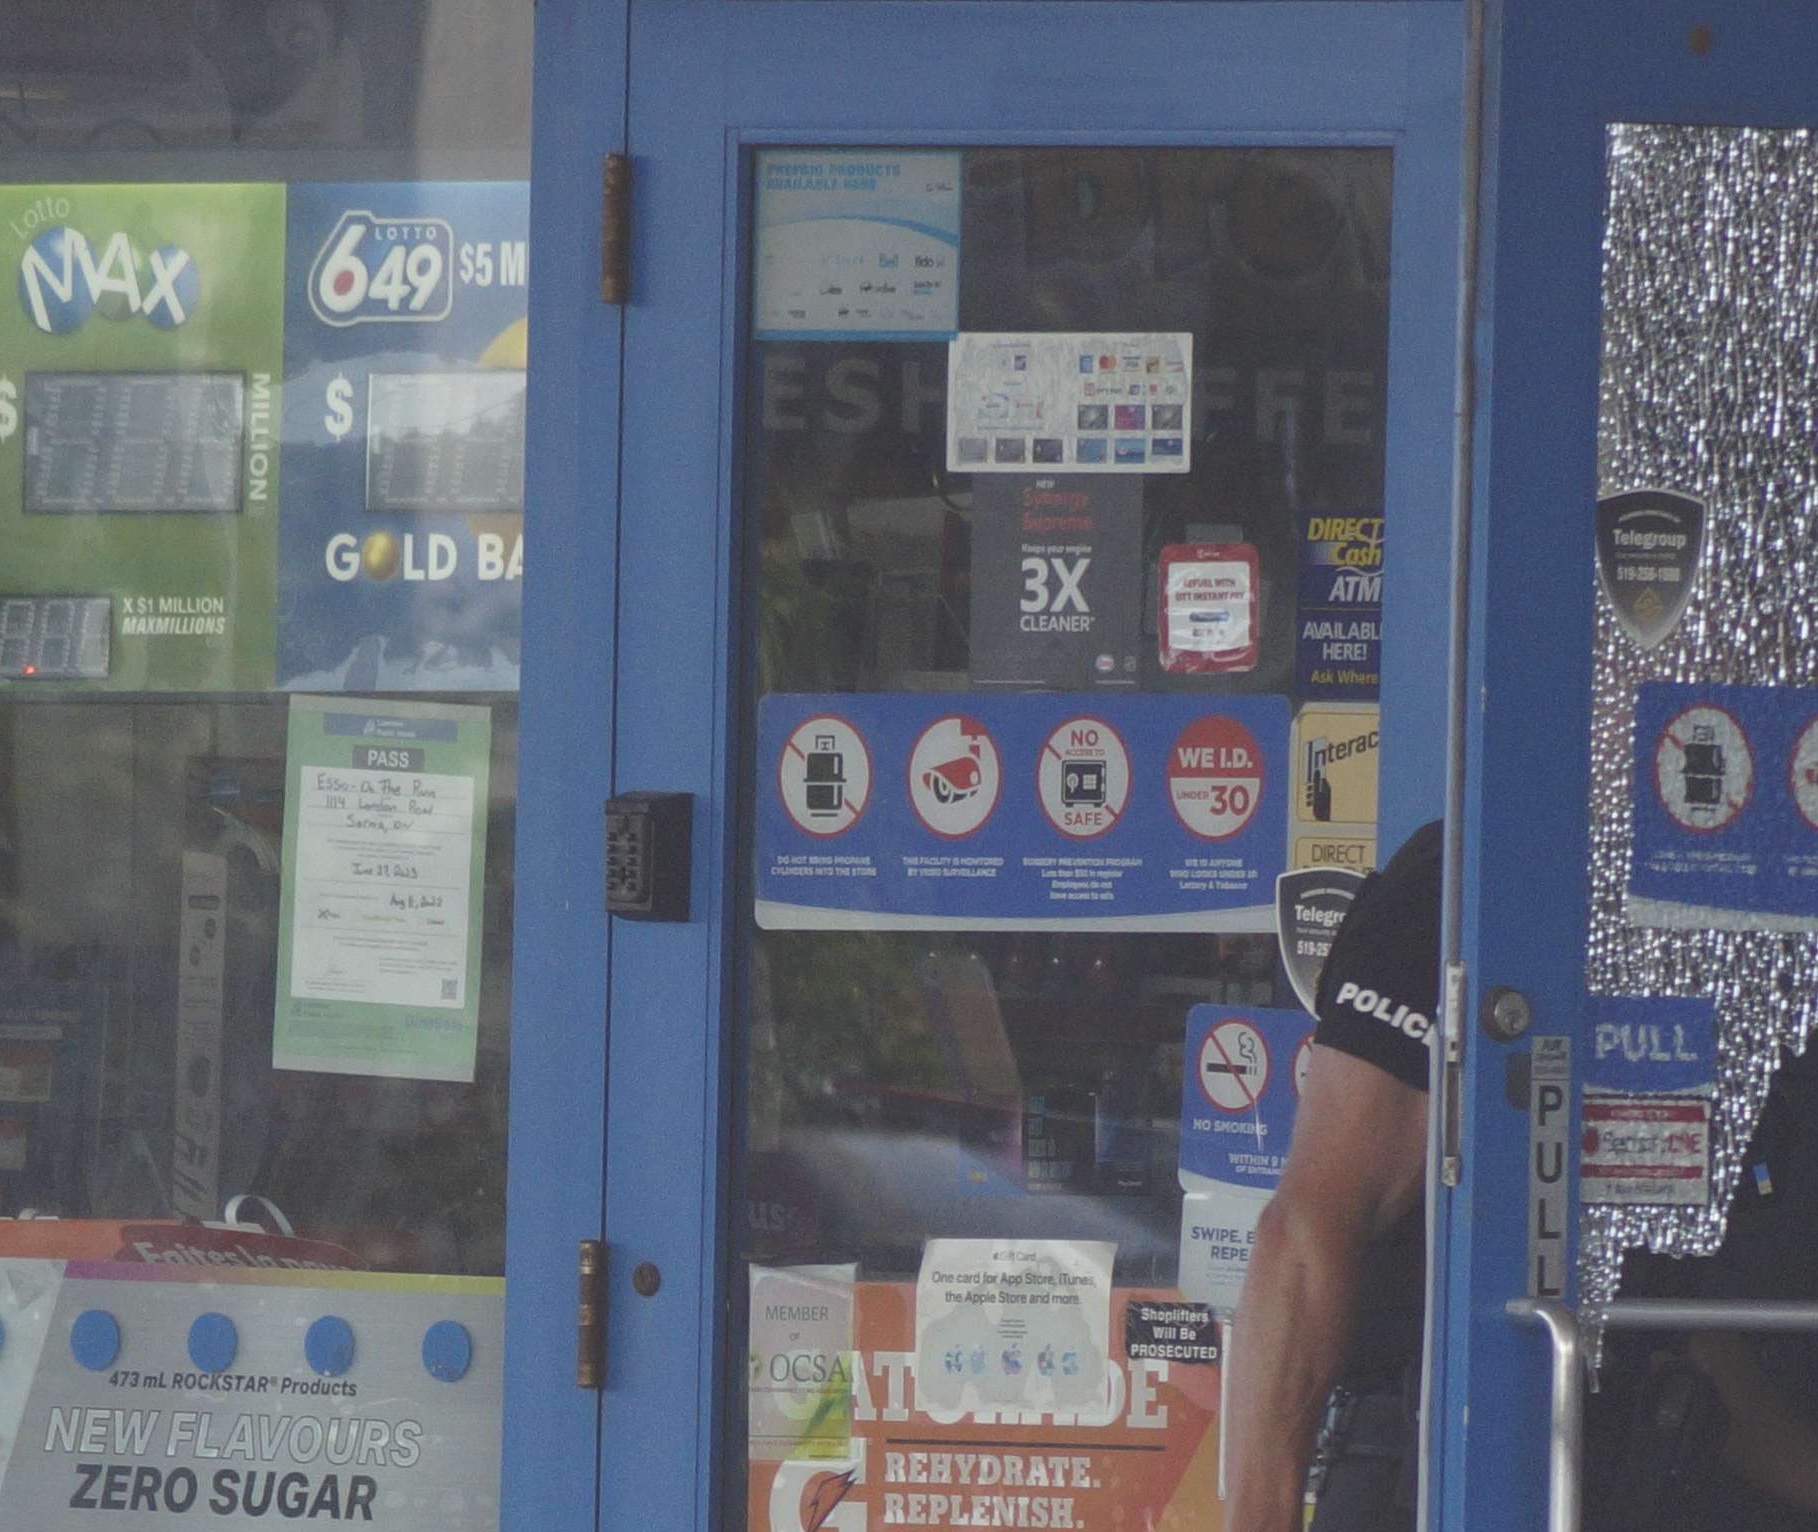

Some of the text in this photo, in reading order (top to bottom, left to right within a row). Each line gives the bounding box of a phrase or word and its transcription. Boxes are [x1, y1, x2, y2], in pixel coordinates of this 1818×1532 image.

[374, 226, 438, 241] LOTTO
[459, 241, 493, 287] $5
[20, 226, 191, 333] MAX
[325, 372, 354, 440] $
[249, 372, 271, 502] MILLION
[1308, 518, 1382, 542] DIRECT
[1613, 529, 1688, 550] Telegroup
[1334, 541, 1380, 567] Cash
[1020, 557, 1091, 613] 3X
[1329, 575, 1380, 603] ATM
[159, 596, 224, 615] MILLION
[122, 616, 226, 636] MAXMILLIONS
[1322, 642, 1368, 661] HERE!
[1311, 669, 1379, 684] Ask Where
[1070, 729, 1099, 747] NO
[368, 750, 409, 767] PASS
[1179, 748, 1253, 769] WE I.D.
[1176, 785, 1250, 815] UNDER 30
[1064, 811, 1103, 828] SAFE
[1312, 844, 1365, 863] DIRECT
[1595, 1023, 1698, 1062] PULL
[1192, 1118, 1269, 1137] NO SMOKING
[1228, 1152, 1269, 1167] WITHIN
[1536, 1085, 1564, 1297] PULL
[1016, 1251, 1037, 1263] Card
[931, 1271, 955, 1287] One
[956, 1271, 981, 1287] card
[982, 1271, 999, 1287] for
[1000, 1271, 1023, 1291] App
[945, 1290, 963, 1305] the
[965, 1290, 997, 1309] Apple
[999, 1290, 1028, 1306] Store
[1030, 1291, 1050, 1306] and
[765, 1305, 830, 1323] MEMBER
[1141, 1308, 1209, 1325] Shoplifters
[1153, 1326, 1197, 1342] Will Be
[1130, 1342, 1218, 1360] PROSECUTED
[770, 1353, 849, 1384] OCSA
[109, 1371, 139, 1388] 473
[143, 1372, 167, 1389] mL
[281, 1378, 358, 1397] Products
[44, 1406, 424, 1469] NEW FLAVOURS
[885, 1451, 1101, 1489] REHYDRATE.
[69, 1463, 378, 1521] ZERO SUGAR
[884, 1492, 1085, 1530] REPLENISH.
